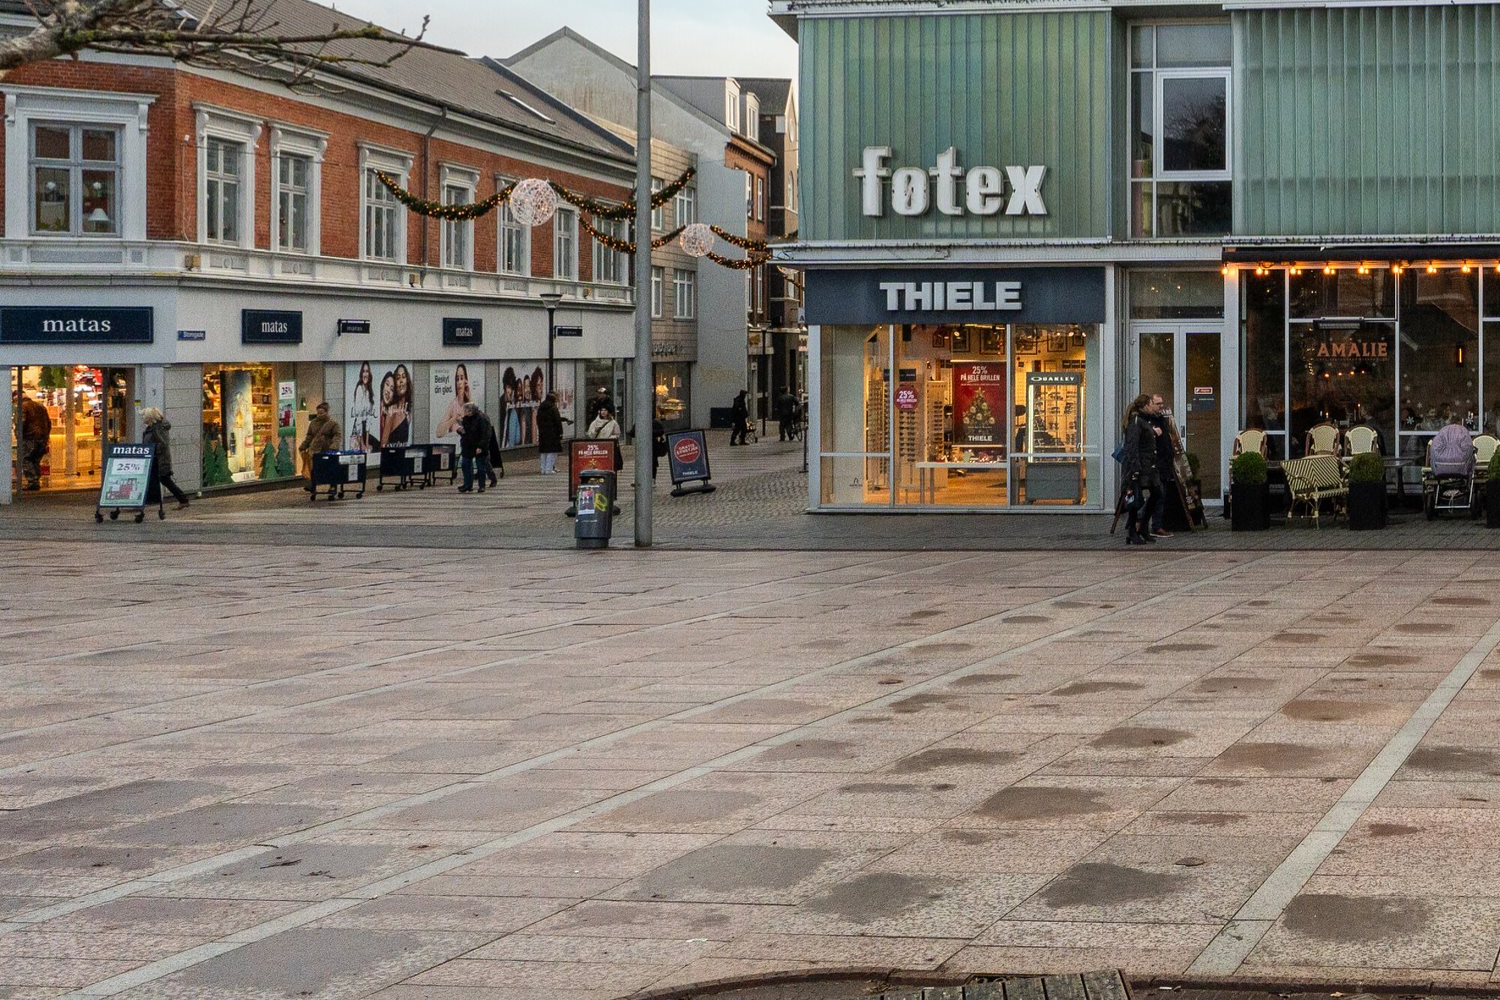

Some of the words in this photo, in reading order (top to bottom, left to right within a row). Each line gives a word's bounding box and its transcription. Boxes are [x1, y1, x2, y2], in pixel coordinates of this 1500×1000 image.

[852, 145, 1048, 217] føtex
[879, 281, 1023, 312] THIELE
[42, 317, 112, 333] matas
[261, 320, 288, 333] matas
[455, 327, 473, 337] matas
[1316, 341, 1388, 357] AMALIE
[972, 365, 988, 375] 25%
[899, 390, 915, 399] 25%
[112, 446, 150, 455] matas
[116, 463, 140, 472] 25%
